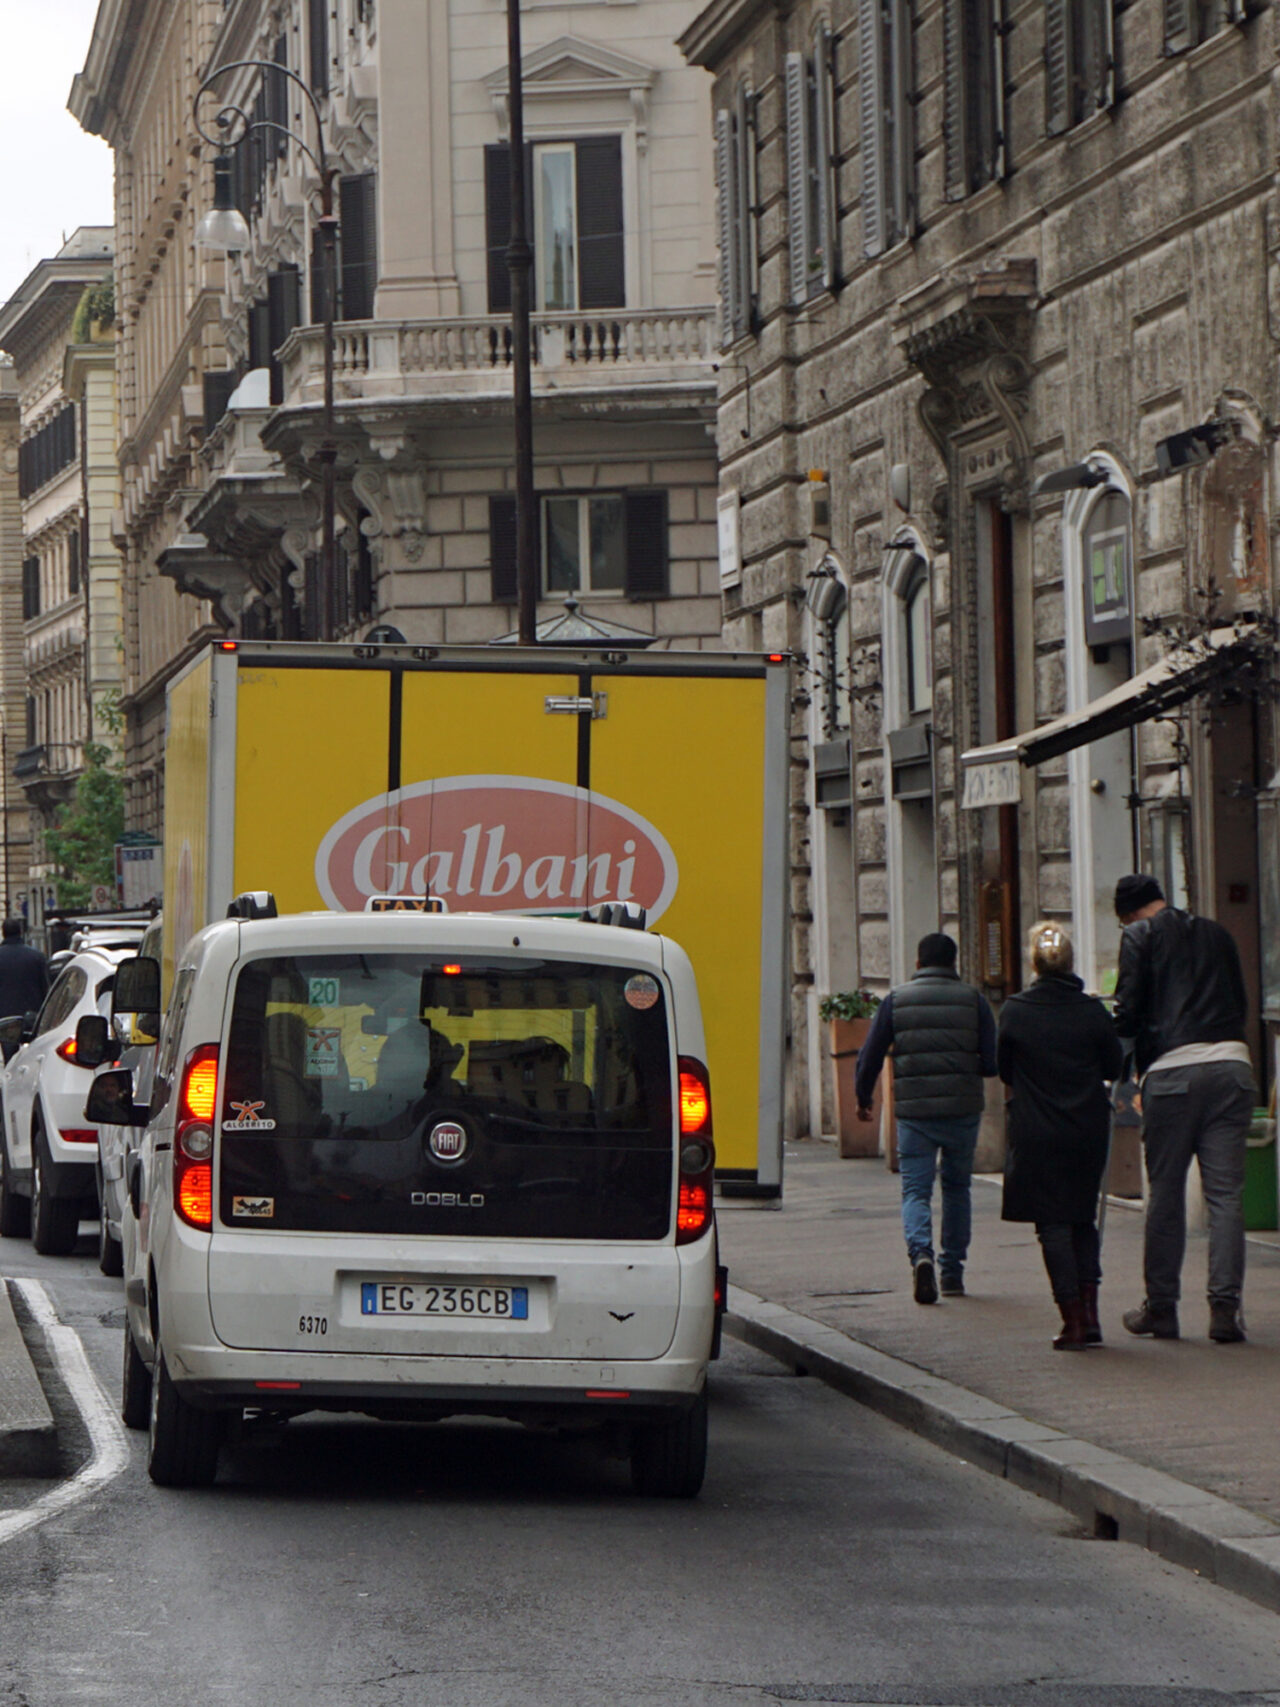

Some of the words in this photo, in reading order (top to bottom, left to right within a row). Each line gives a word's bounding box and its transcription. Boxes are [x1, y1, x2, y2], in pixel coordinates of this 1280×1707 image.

[353, 823, 636, 901] Galbani
[374, 900, 439, 913] TAXI
[312, 981, 337, 1004] 20
[438, 1132, 460, 1151] FIAT
[381, 1285, 414, 1312] EG
[425, 1287, 510, 1315] 236CB
[299, 1315, 328, 1335] 6370
